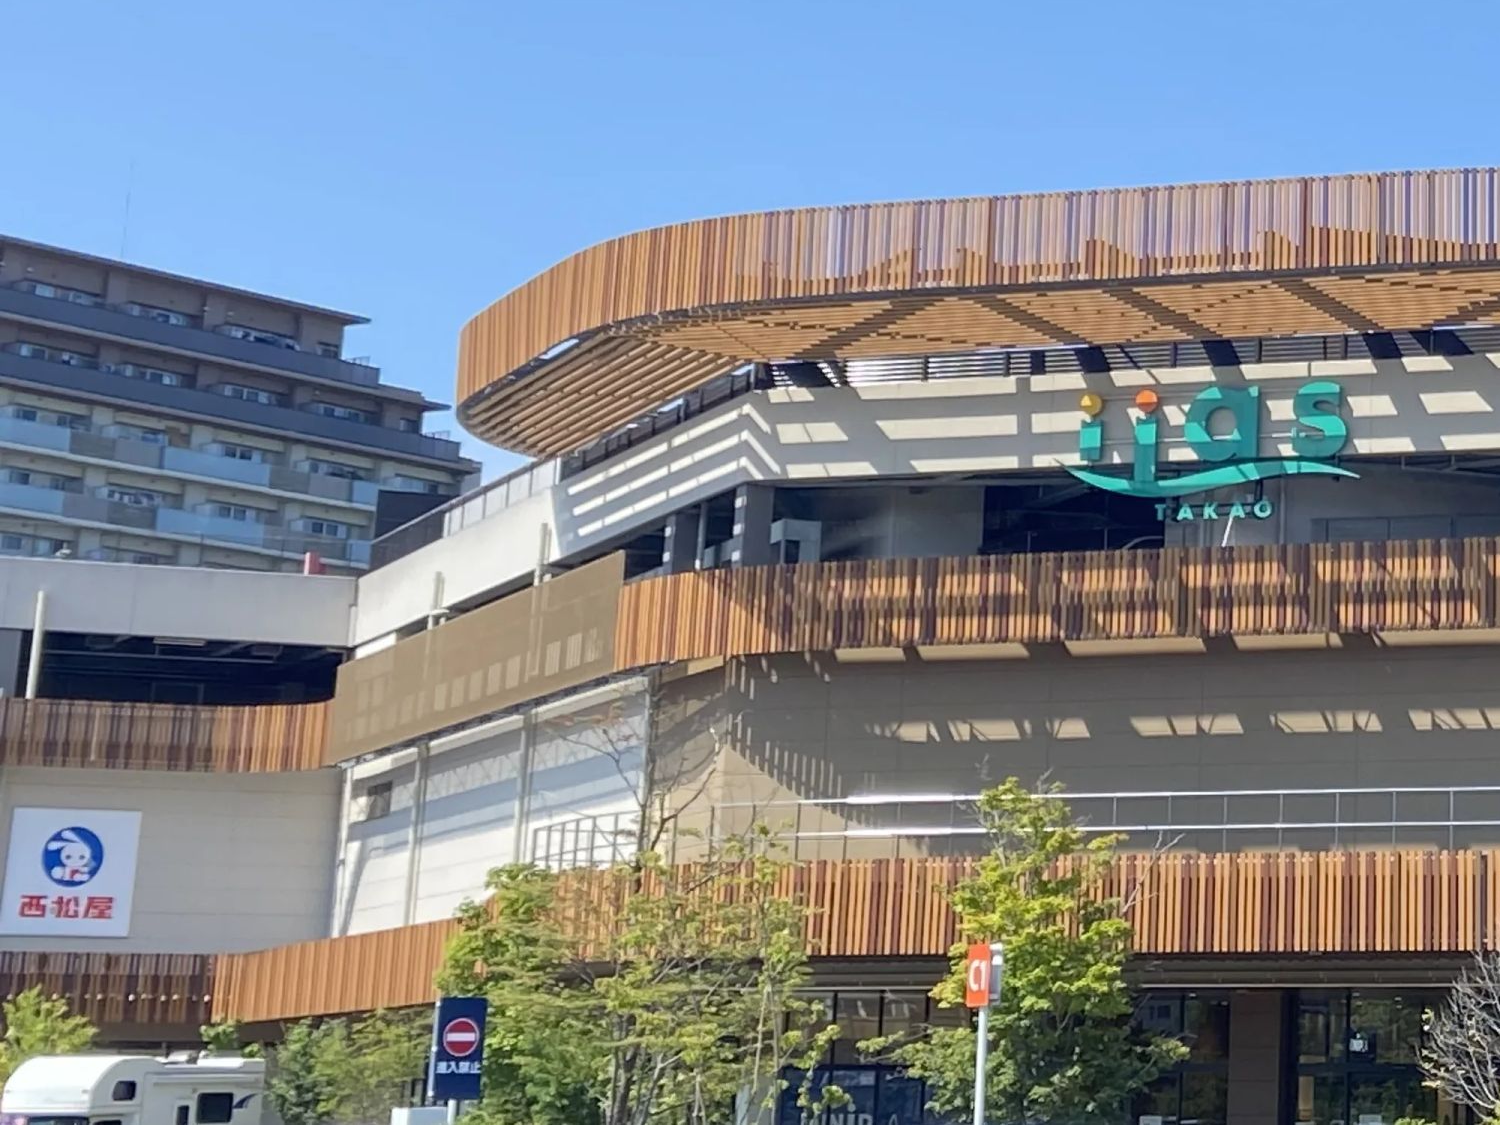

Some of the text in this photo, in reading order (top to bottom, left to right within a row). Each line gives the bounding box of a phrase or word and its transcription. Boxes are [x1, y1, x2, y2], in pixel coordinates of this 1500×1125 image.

[1154, 499, 1272, 521] TAKAO
[18, 894, 115, 919] 西松屋
[969, 959, 988, 992] C1
